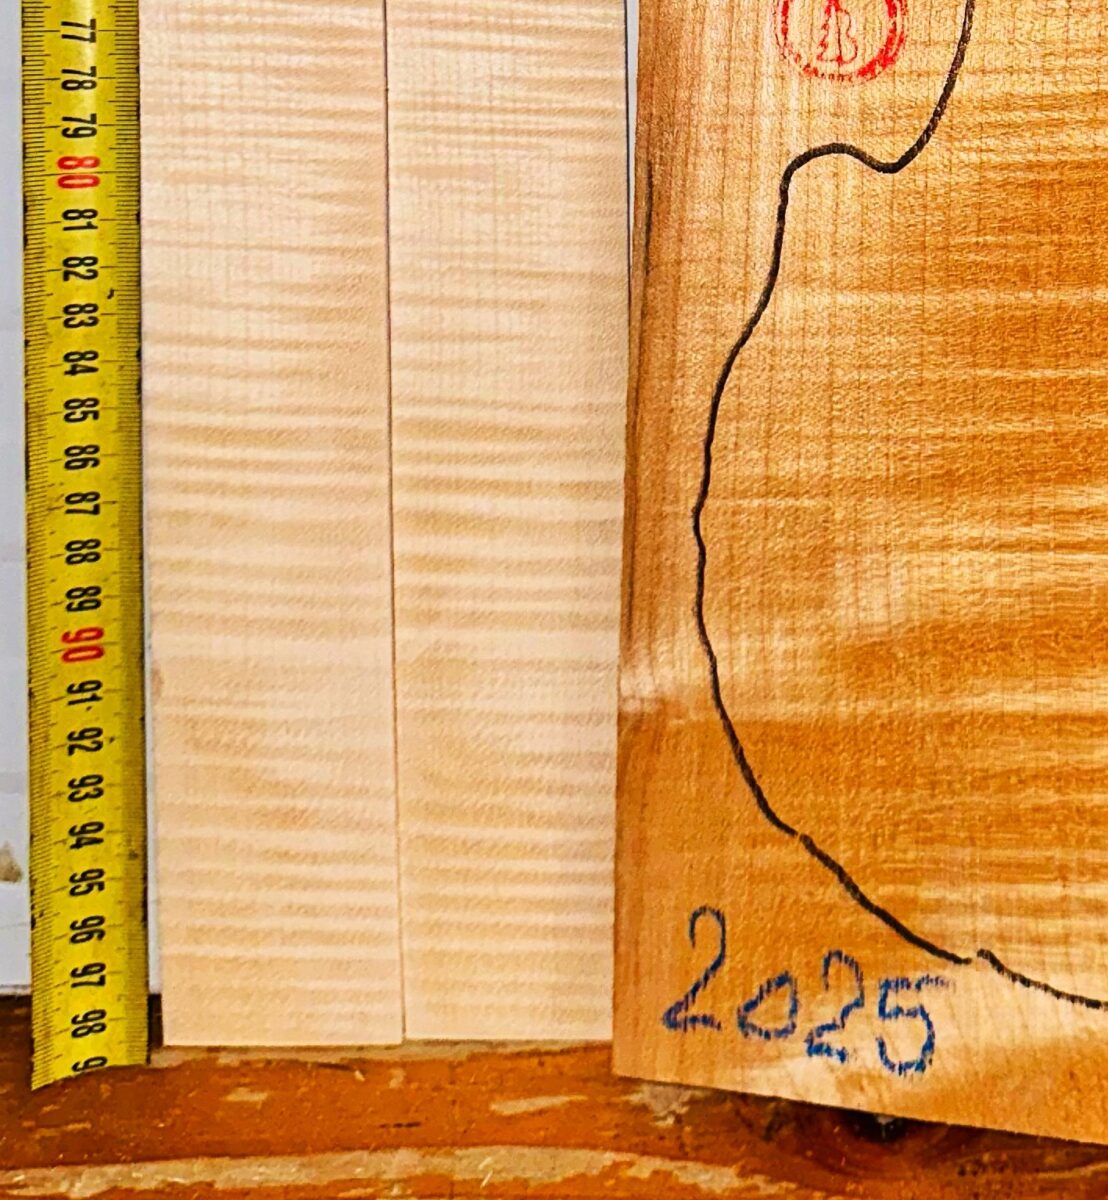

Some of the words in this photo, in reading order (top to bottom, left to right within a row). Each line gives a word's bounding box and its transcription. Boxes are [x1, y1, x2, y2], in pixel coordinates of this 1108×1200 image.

[61, 18, 97, 43] 77
[61, 66, 97, 91] 78
[61, 113, 98, 139] 79
[57, 156, 102, 189] 80
[62, 208, 99, 232] 81
[62, 256, 99, 282] 82
[63, 303, 99, 329] 83
[63, 350, 100, 376] 84
[64, 397, 100, 423] 85
[64, 444, 101, 471] 86
[65, 491, 101, 516] 87
[65, 538, 102, 565] 88
[65, 585, 102, 612] 89
[61, 627, 106, 663] 90
[66, 680, 103, 707] 91
[67, 727, 103, 756] 92
[67, 774, 104, 803] 93
[68, 821, 105, 850] 94
[69, 868, 105, 897] 95
[70, 915, 106, 944] 96
[70, 962, 107, 989] 97
[662, 904, 956, 1078] 2025
[71, 1009, 107, 1038] 98
